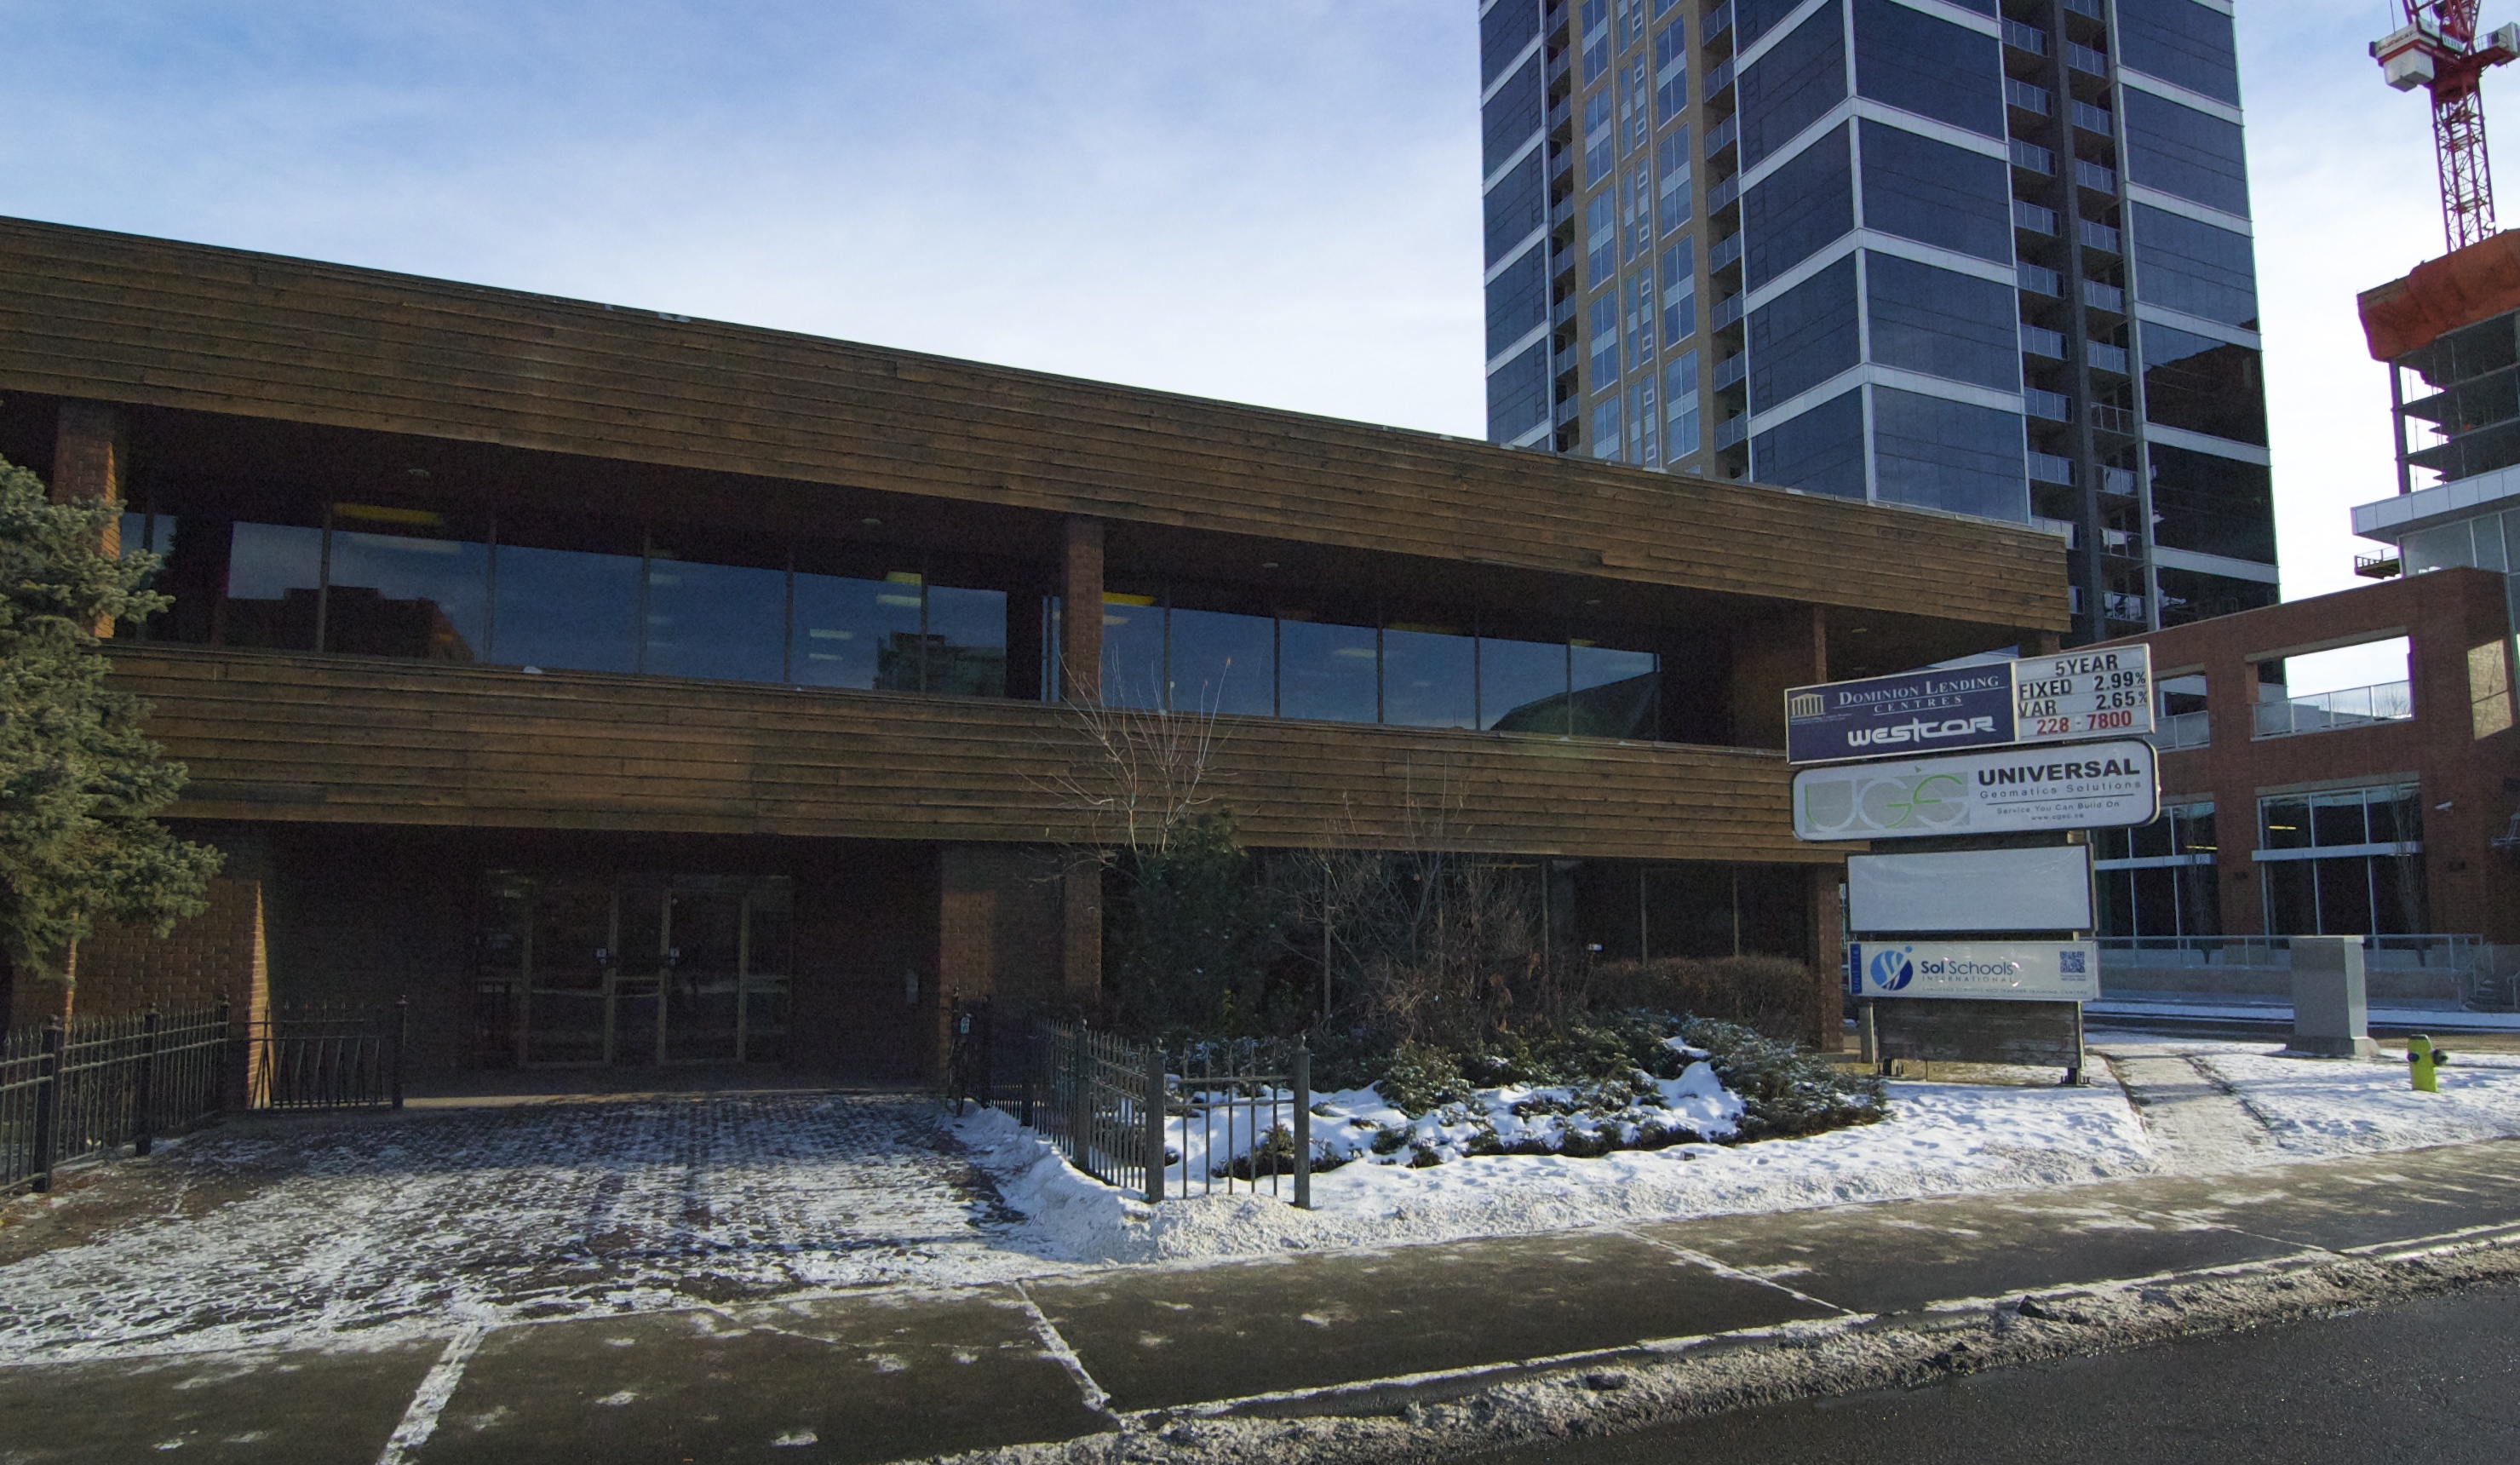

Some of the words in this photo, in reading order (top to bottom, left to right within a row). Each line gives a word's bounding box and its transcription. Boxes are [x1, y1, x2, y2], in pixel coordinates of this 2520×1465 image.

[1840, 686, 1919, 705] DOMINION
[1926, 675, 2000, 695] LENDING
[2018, 679, 2072, 699] FIXED
[2093, 670, 2146, 692] 2.99%
[1874, 695, 1962, 714] CENTRES
[2018, 699, 2057, 718] VAR
[2096, 690, 2148, 710] 2.65%
[1847, 715, 1997, 747] WESTCOR
[1978, 757, 2141, 786] UNIVERSAL
[1980, 785, 2058, 799] Geomatics
[2066, 781, 2142, 793] Solutions
[1996, 807, 2031, 815] Service
[2035, 804, 2052, 813] You
[2078, 801, 2102, 810] Build
[1920, 960, 1944, 974] Sol
[1949, 960, 2013, 975] Schools
[1921, 975, 2013, 984] INTERNATIONAL
